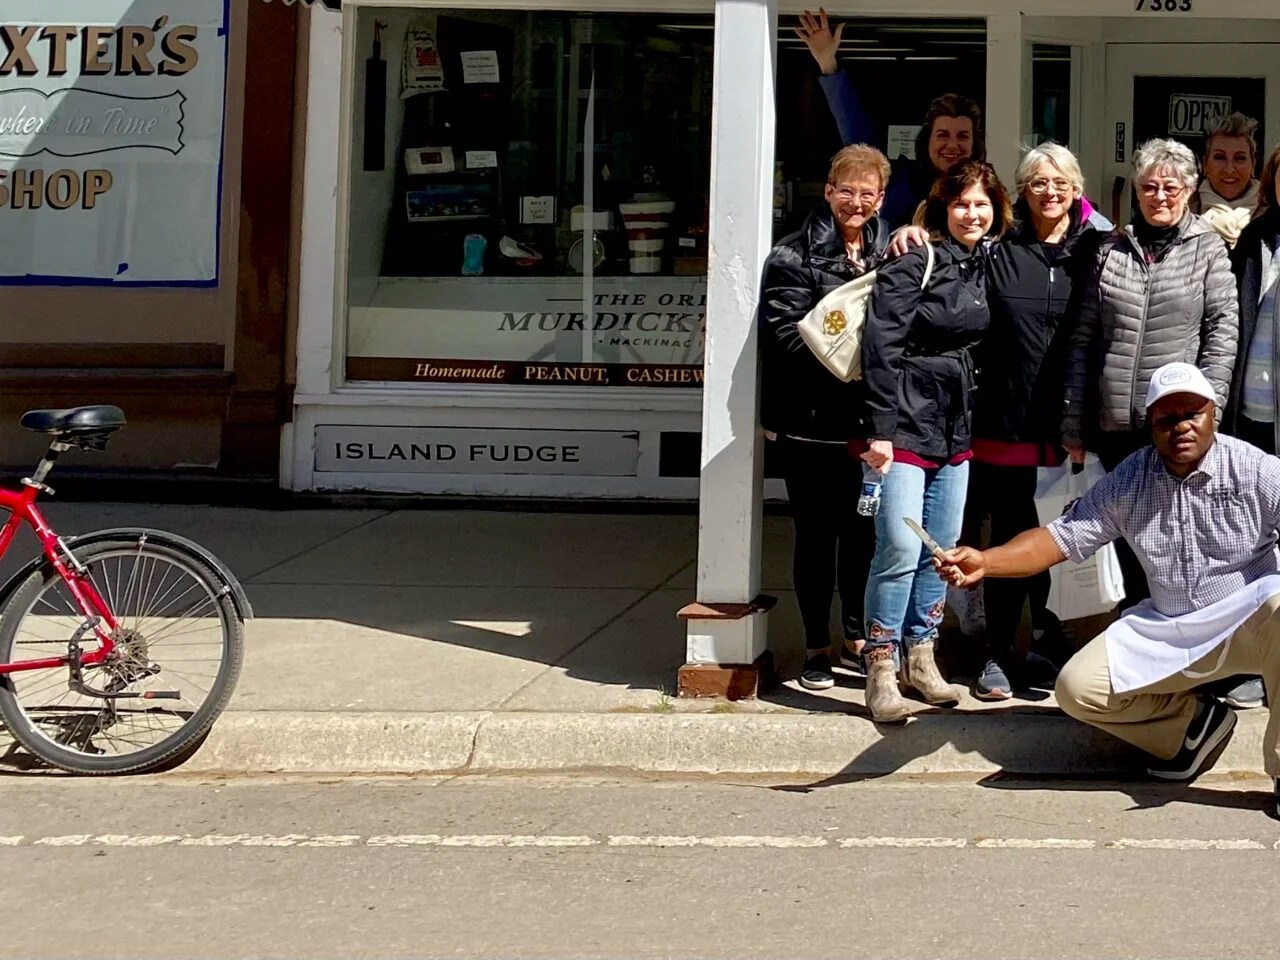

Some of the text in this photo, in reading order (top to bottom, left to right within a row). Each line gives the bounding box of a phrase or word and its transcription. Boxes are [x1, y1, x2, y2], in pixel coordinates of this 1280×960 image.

[1116, 123, 1125, 161] PULL
[594, 293, 647, 306] THE
[497, 312, 708, 332] MURDICK'
[609, 337, 691, 348] MACKINAC
[414, 363, 505, 380] Homemade
[524, 366, 610, 384] PEANUT,
[335, 442, 580, 463] ISLAND FUDGE
